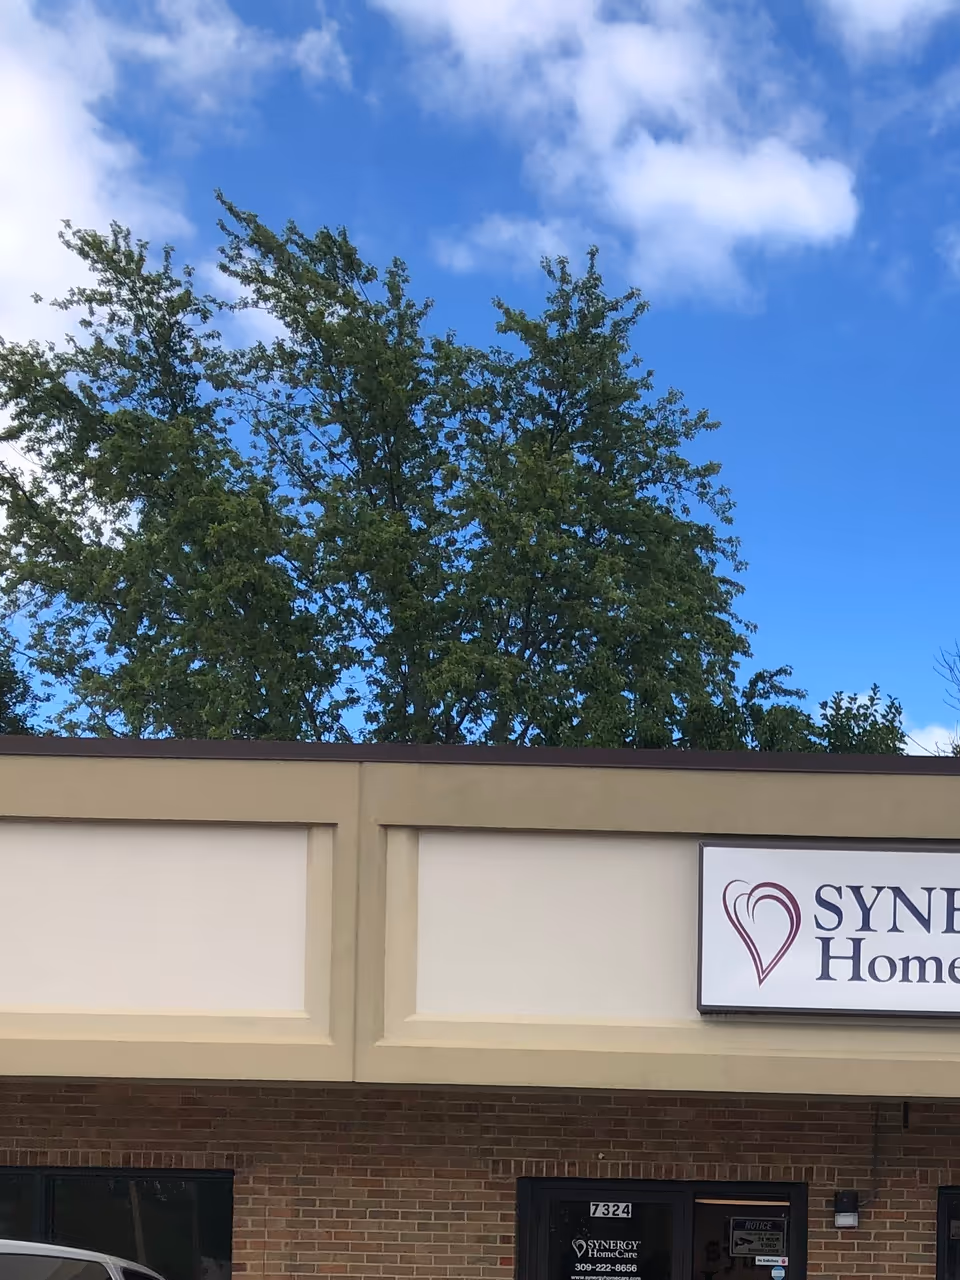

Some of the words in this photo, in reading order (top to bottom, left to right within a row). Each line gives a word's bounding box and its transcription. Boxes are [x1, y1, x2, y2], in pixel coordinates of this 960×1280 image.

[591, 1203, 631, 1217] 7324
[587, 1248, 638, 1259] HomeCare
[574, 1263, 638, 1273] 309-222-8656
